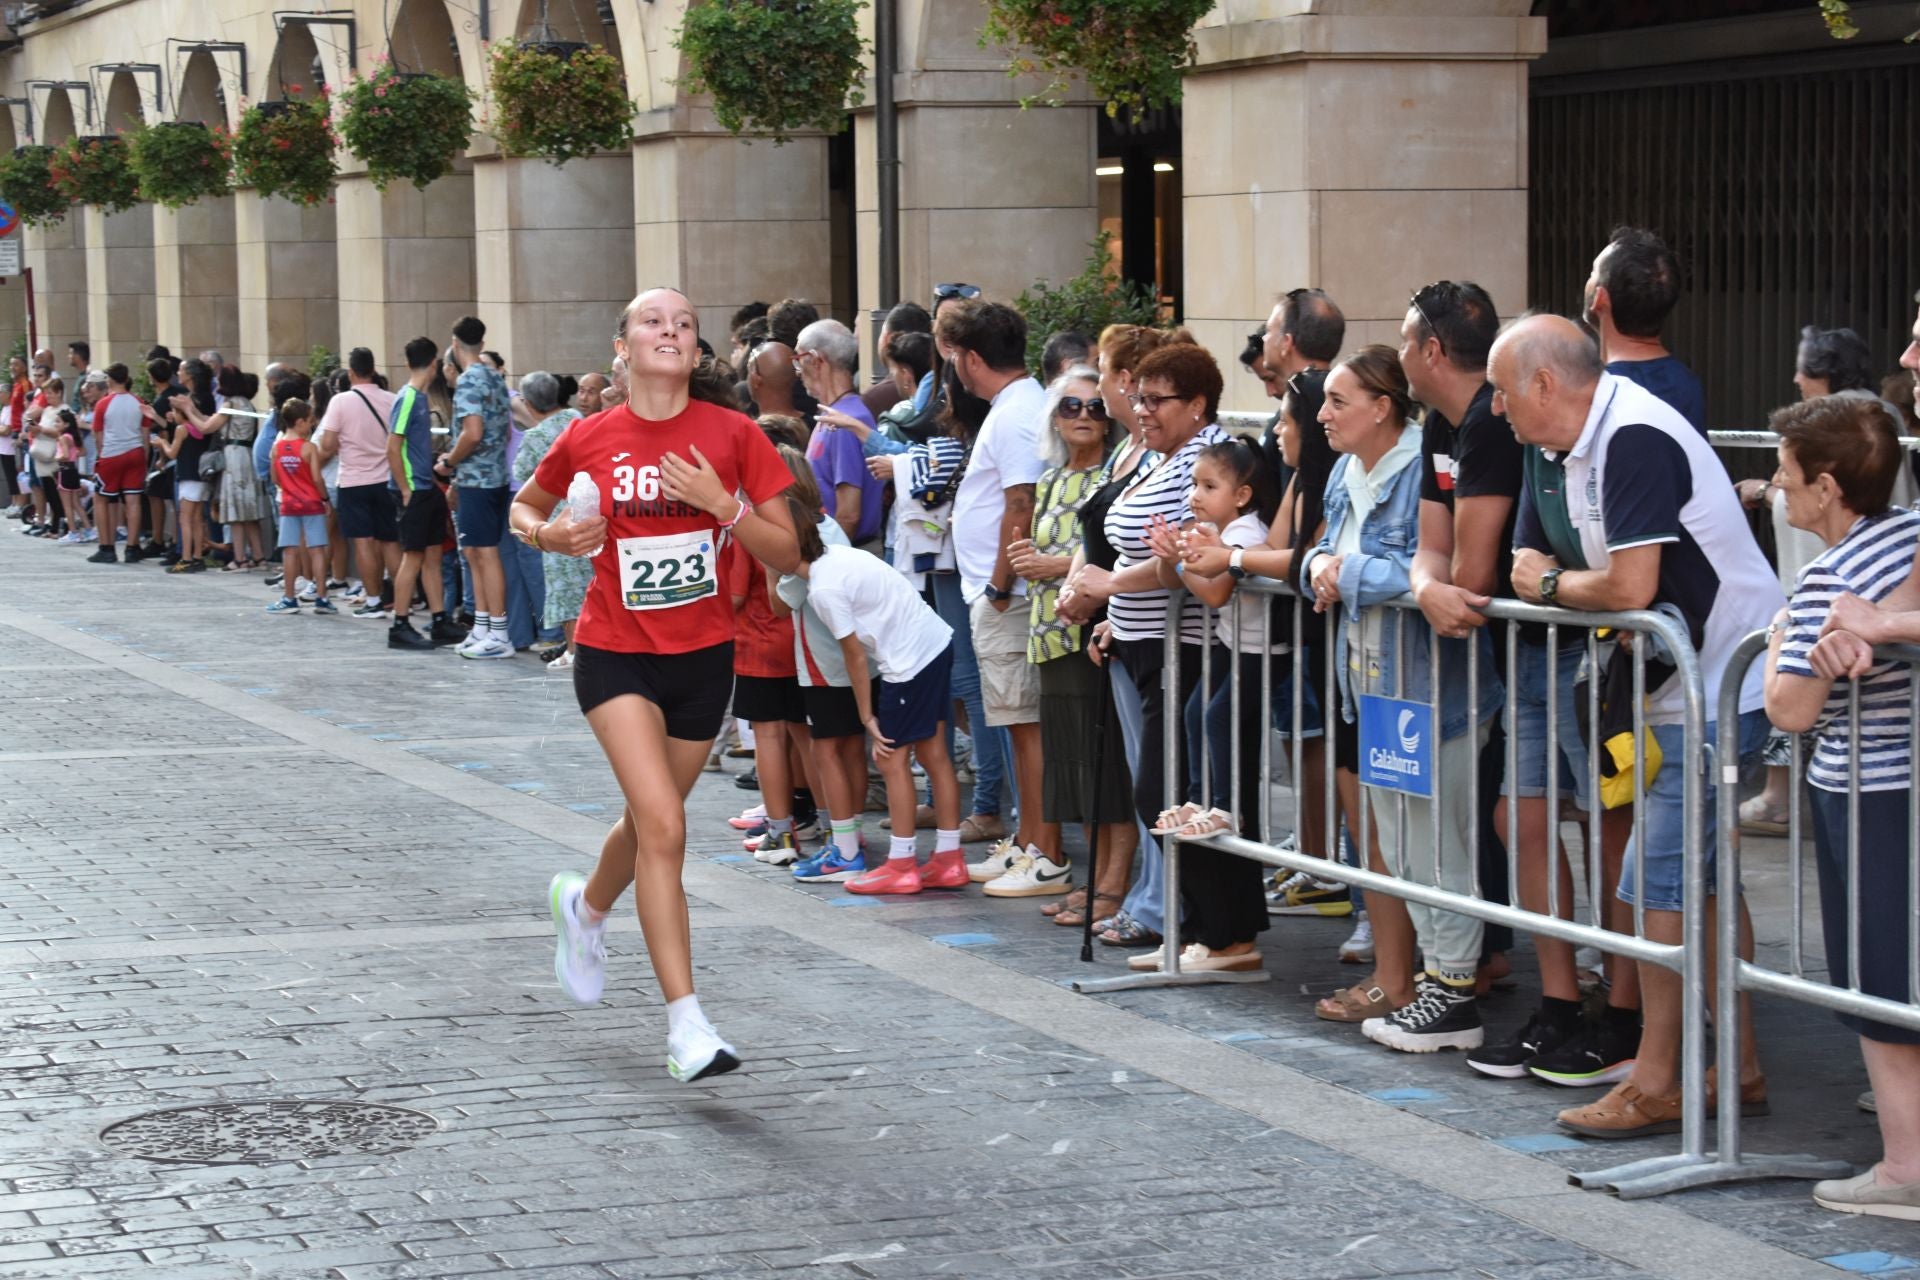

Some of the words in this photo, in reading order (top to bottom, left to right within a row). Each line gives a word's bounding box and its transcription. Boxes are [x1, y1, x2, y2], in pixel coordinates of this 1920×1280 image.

[612, 465, 682, 502] 36
[631, 553, 706, 589] 223
[1370, 747, 1421, 776] Calahorra
